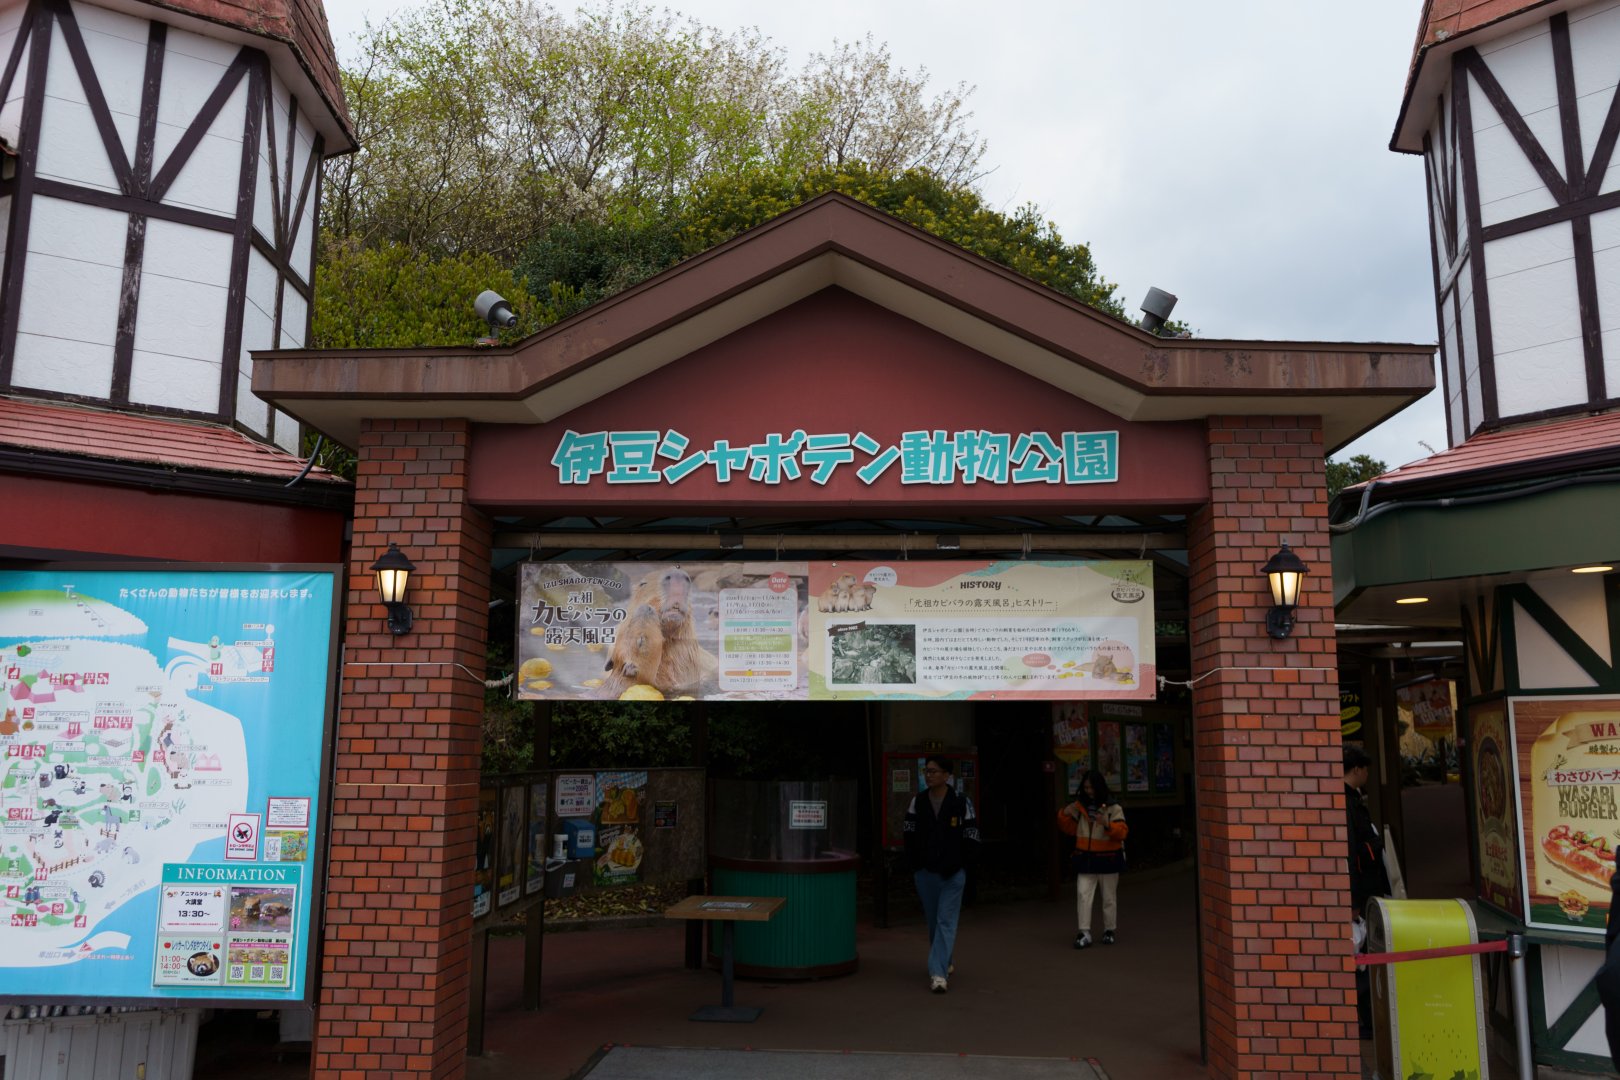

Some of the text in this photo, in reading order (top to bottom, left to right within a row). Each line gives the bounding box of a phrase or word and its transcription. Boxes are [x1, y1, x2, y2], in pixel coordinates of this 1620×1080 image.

[551, 430, 1119, 484] 伊豆シャボテン動物公園
[543, 580, 557, 589] IZU
[603, 580, 622, 589] ZOO
[960, 581, 1001, 590] HISTORY
[120, 587, 314, 599] たくさんの動物たちが皆様をお迎えします。
[568, 592, 593, 603] 元祖
[532, 600, 627, 625] カピバラの
[546, 627, 616, 645] 露天風呂
[1590, 723, 1620, 737] WA
[1589, 744, 1620, 753] 特製わ
[1557, 785, 1615, 805] WASABI
[1559, 801, 1618, 820] BURGER
[178, 867, 286, 881] INFORMATION
[39, 951, 61, 959] 車出口
